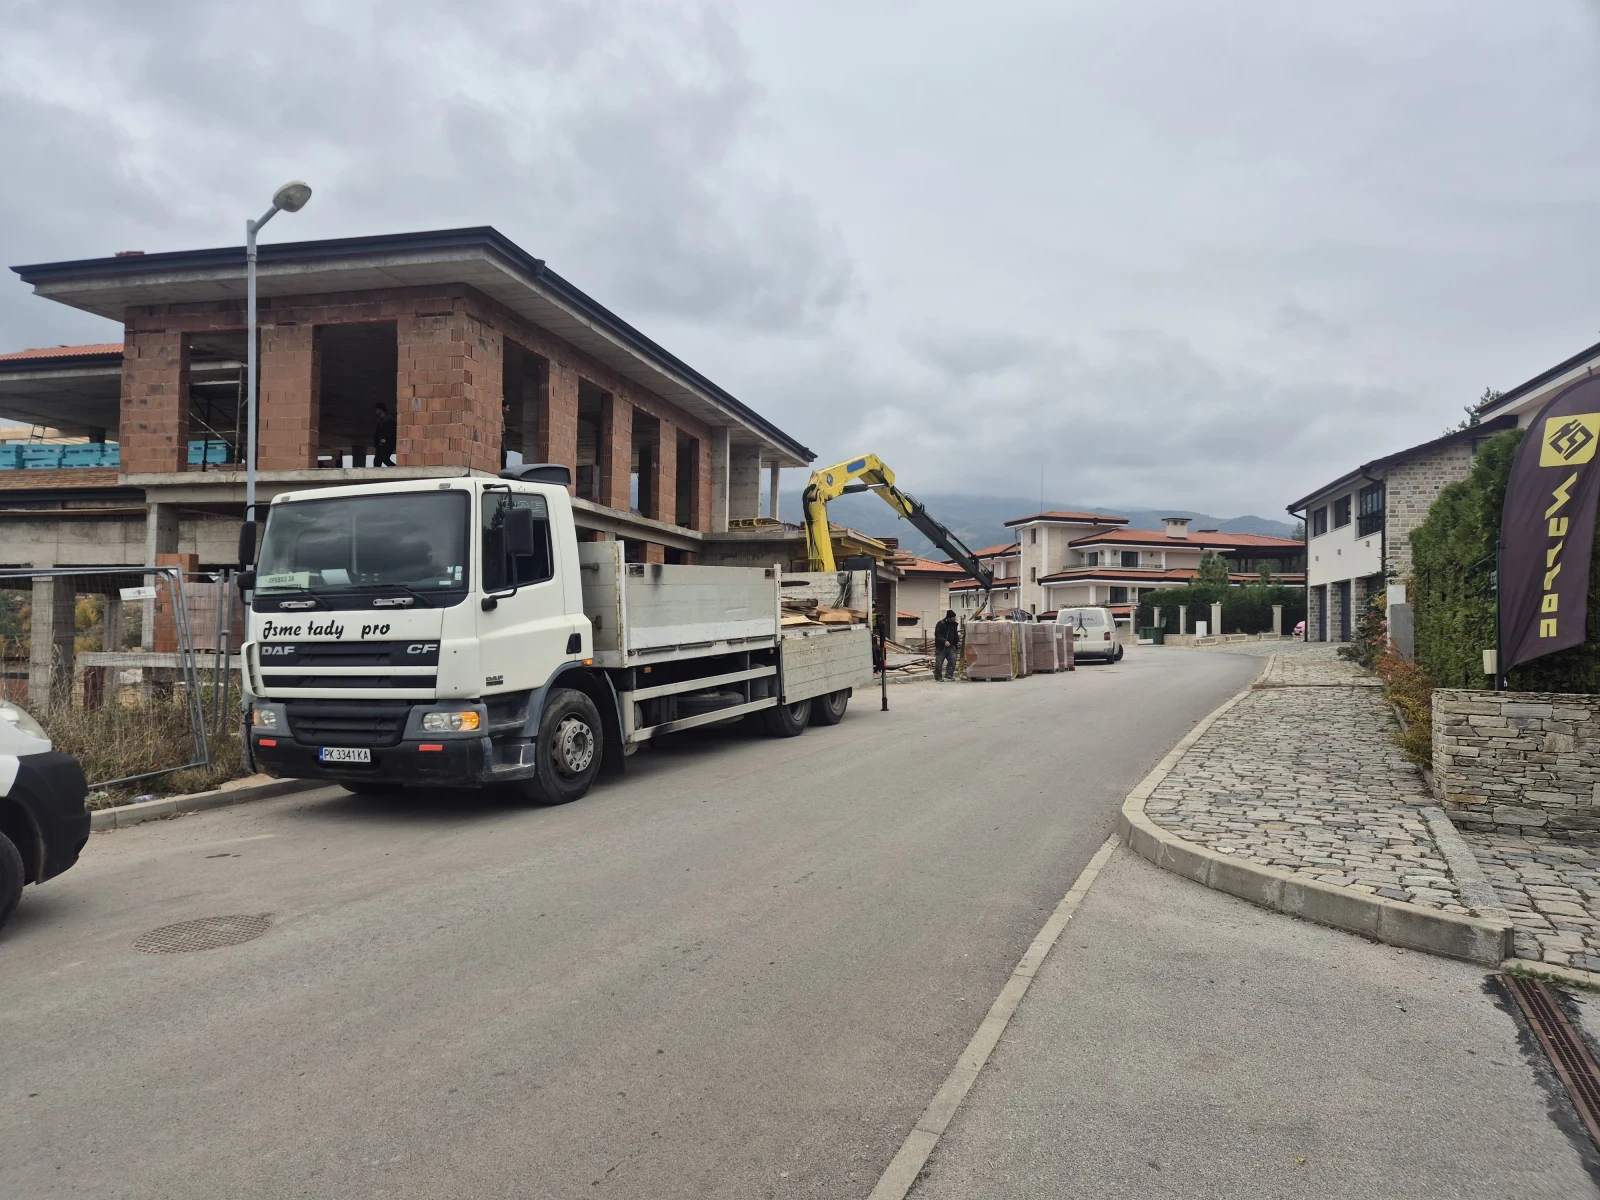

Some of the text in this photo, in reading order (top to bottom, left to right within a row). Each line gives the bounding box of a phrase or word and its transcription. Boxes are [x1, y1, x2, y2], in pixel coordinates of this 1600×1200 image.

[307, 620, 344, 639] tady
[361, 623, 391, 639] pro
[261, 646, 295, 655] DAF
[406, 644, 438, 654] CF
